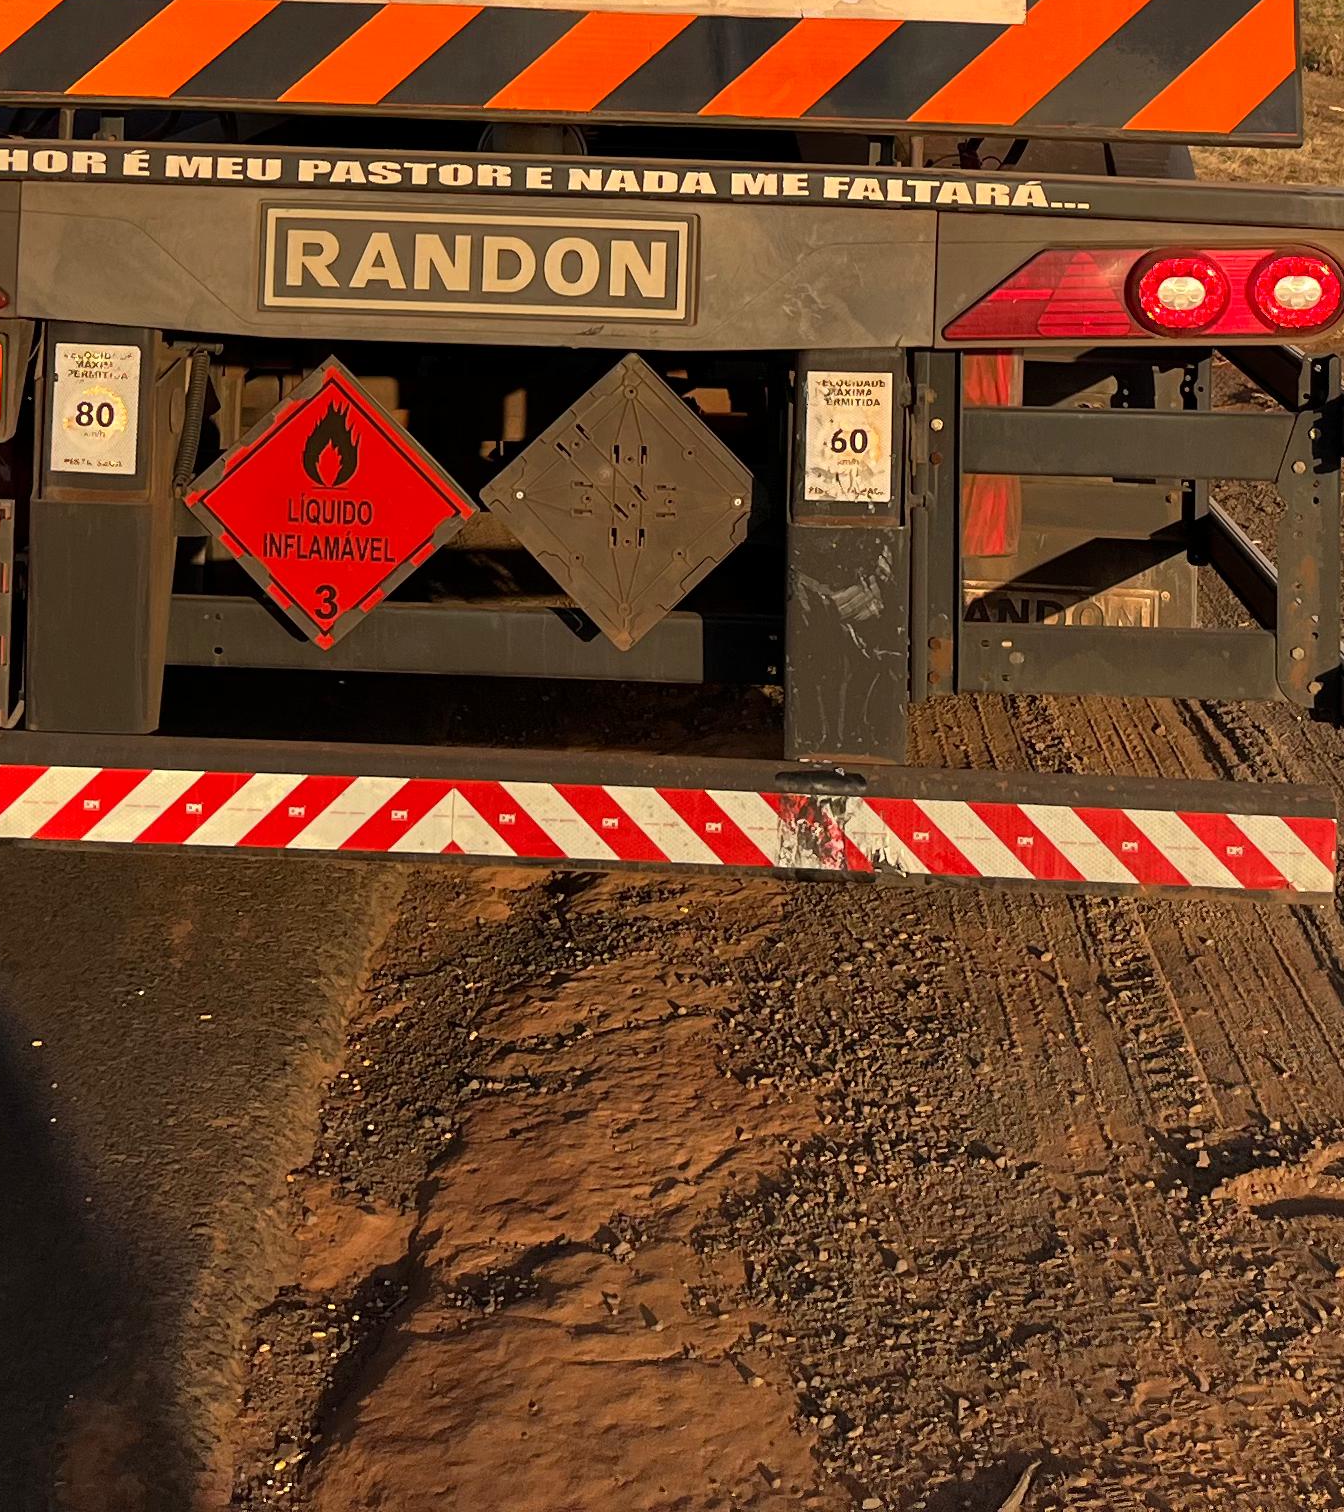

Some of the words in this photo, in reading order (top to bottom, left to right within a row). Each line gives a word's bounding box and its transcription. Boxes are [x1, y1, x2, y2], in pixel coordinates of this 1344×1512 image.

[123, 148, 150, 176] É
[165, 155, 282, 182] MEU
[298, 160, 512, 187] PASTOR
[526, 167, 553, 190] E
[568, 168, 717, 194] NADA
[730, 172, 809, 196] ME
[285, 229, 668, 298] RANDON
[76, 401, 114, 427] 80
[830, 428, 868, 454] 60
[287, 493, 373, 526] LÍQUIDO
[262, 530, 396, 564] INFLAMÁVEL
[314, 584, 338, 620] 3
